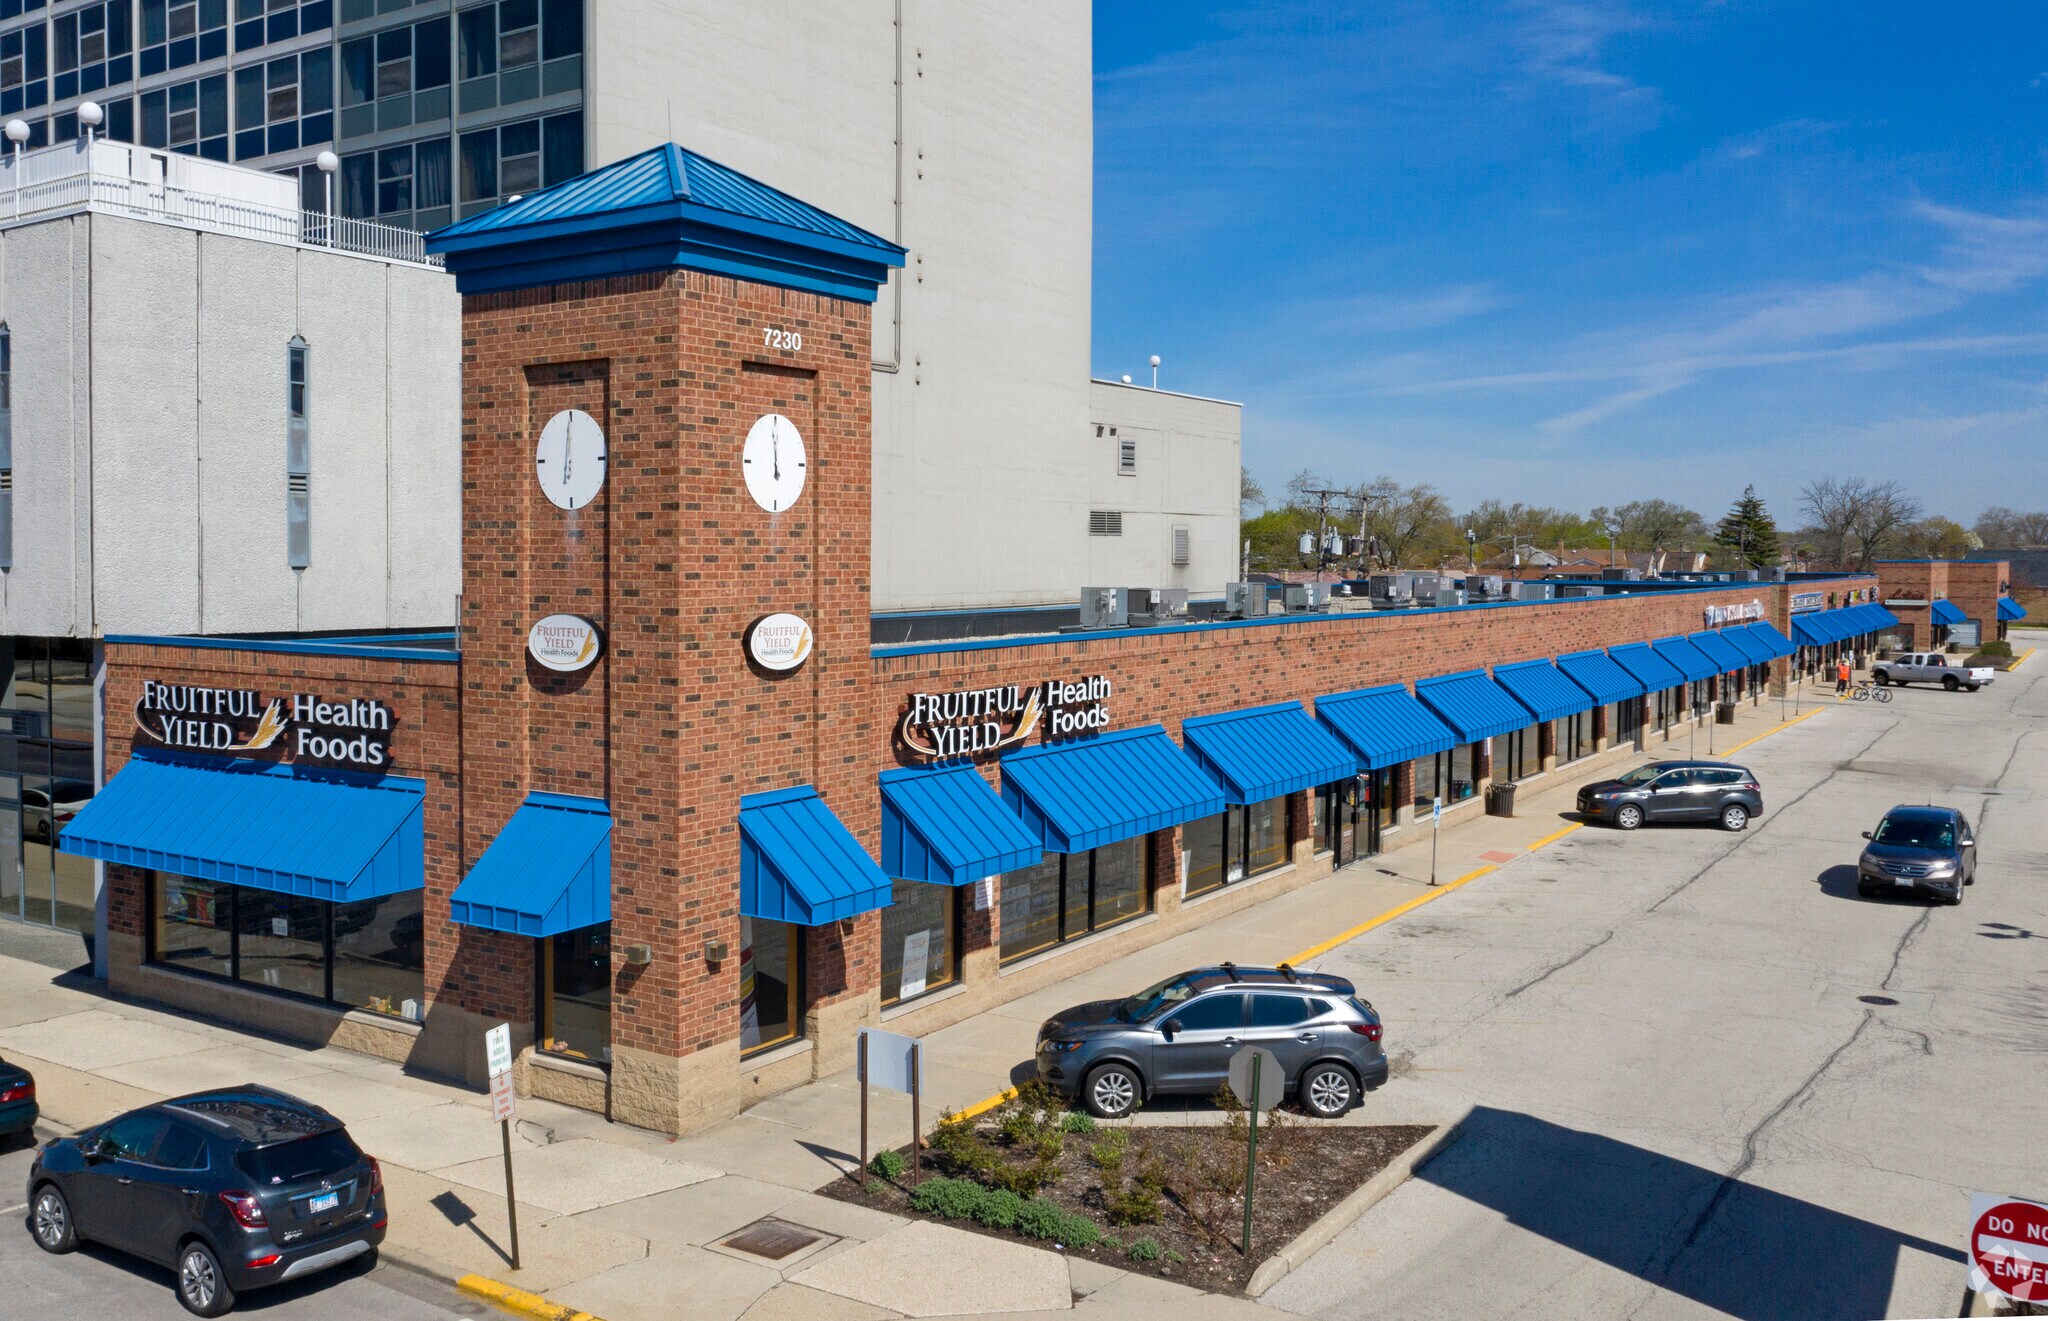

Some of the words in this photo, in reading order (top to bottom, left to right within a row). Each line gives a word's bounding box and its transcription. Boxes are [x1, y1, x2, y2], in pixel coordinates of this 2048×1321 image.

[763, 327, 802, 351] 7230
[537, 625, 585, 638] FRUITFUL
[544, 637, 575, 649] YIELD
[758, 626, 801, 637] FRUITFUL
[764, 637, 791, 648] YIELD
[541, 648, 560, 656] Health
[143, 680, 260, 718] FRUITFUL
[1047, 675, 1111, 707] Health
[293, 694, 388, 730] Health
[912, 685, 1024, 725] FRUITFUL
[1052, 703, 1110, 735] Foods
[159, 715, 232, 750] YIELD
[931, 722, 1001, 757] YIELD
[297, 728, 383, 765] Foods
[492, 1034, 504, 1046] TWO
[492, 1045, 505, 1057] HOUR
[490, 1055, 509, 1069] PARKING
[1988, 1215, 2015, 1234] DO
[1994, 1259, 2048, 1285] ENTE
